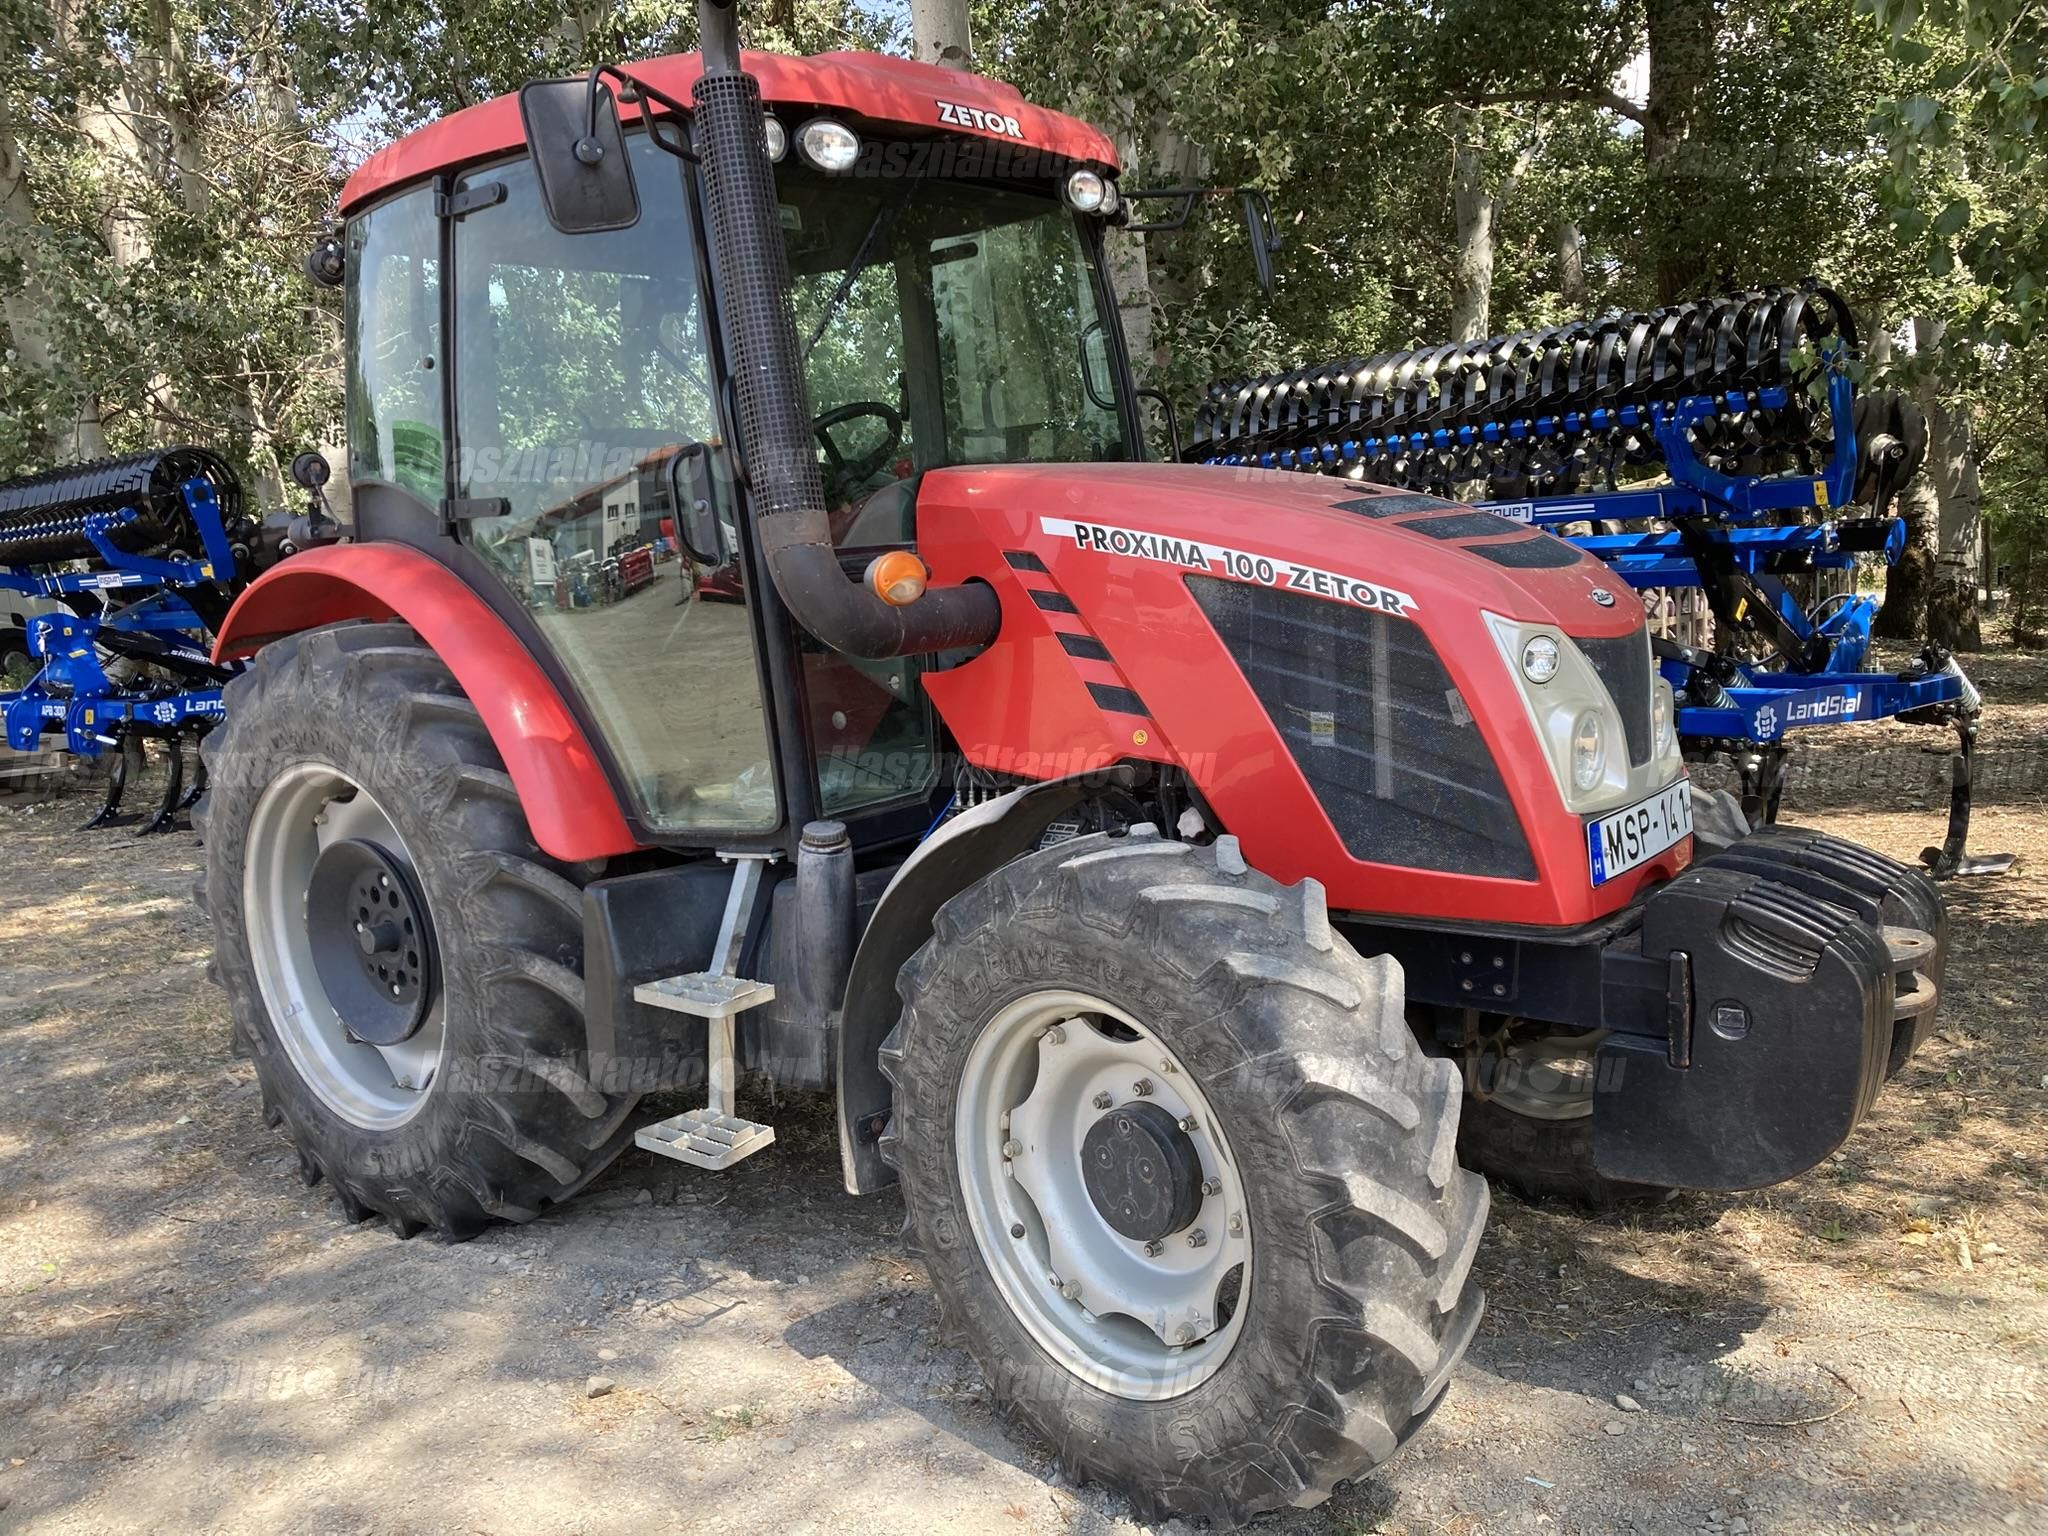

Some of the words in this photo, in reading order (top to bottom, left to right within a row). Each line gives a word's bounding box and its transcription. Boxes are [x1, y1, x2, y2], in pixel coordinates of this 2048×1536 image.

[936, 100, 1025, 139] ZETOR
[1075, 523, 1206, 569] PROXIMA
[1222, 551, 1275, 583] 100
[1290, 566, 1403, 614] ZETOR
[1787, 692, 1862, 720] LandStal
[1606, 788, 1688, 870] MSP-141
[1594, 858, 1602, 875] H
